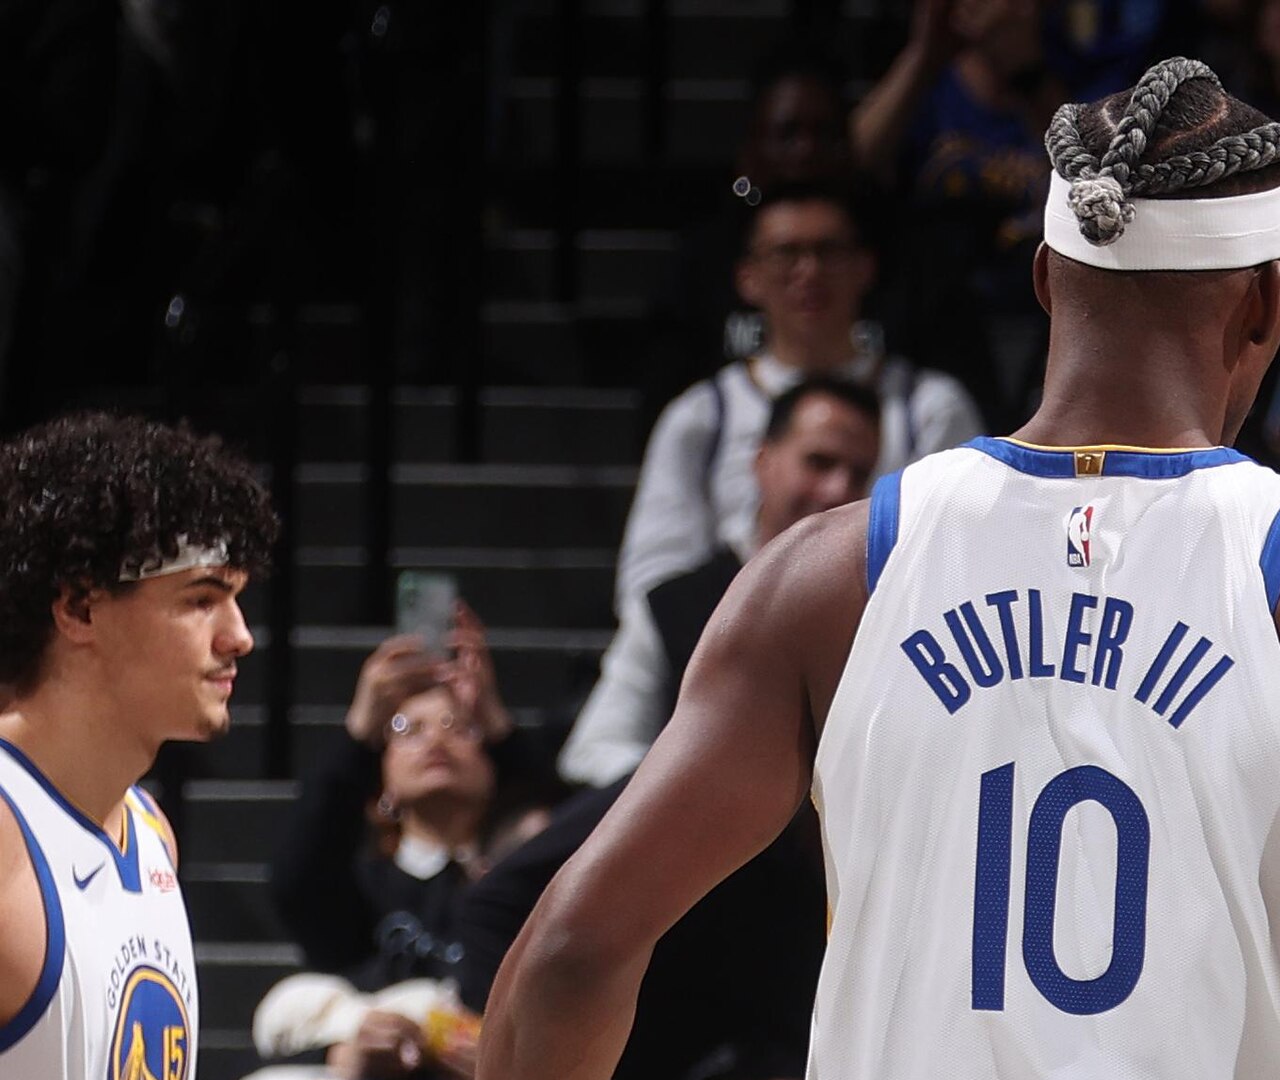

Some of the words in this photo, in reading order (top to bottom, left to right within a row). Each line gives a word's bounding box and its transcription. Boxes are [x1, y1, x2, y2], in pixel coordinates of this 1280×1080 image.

[901, 588, 1134, 715] BUTLER
[1134, 622, 1234, 729] III
[971, 762, 1150, 1016] 10
[107, 935, 147, 1009] GOLDEN
